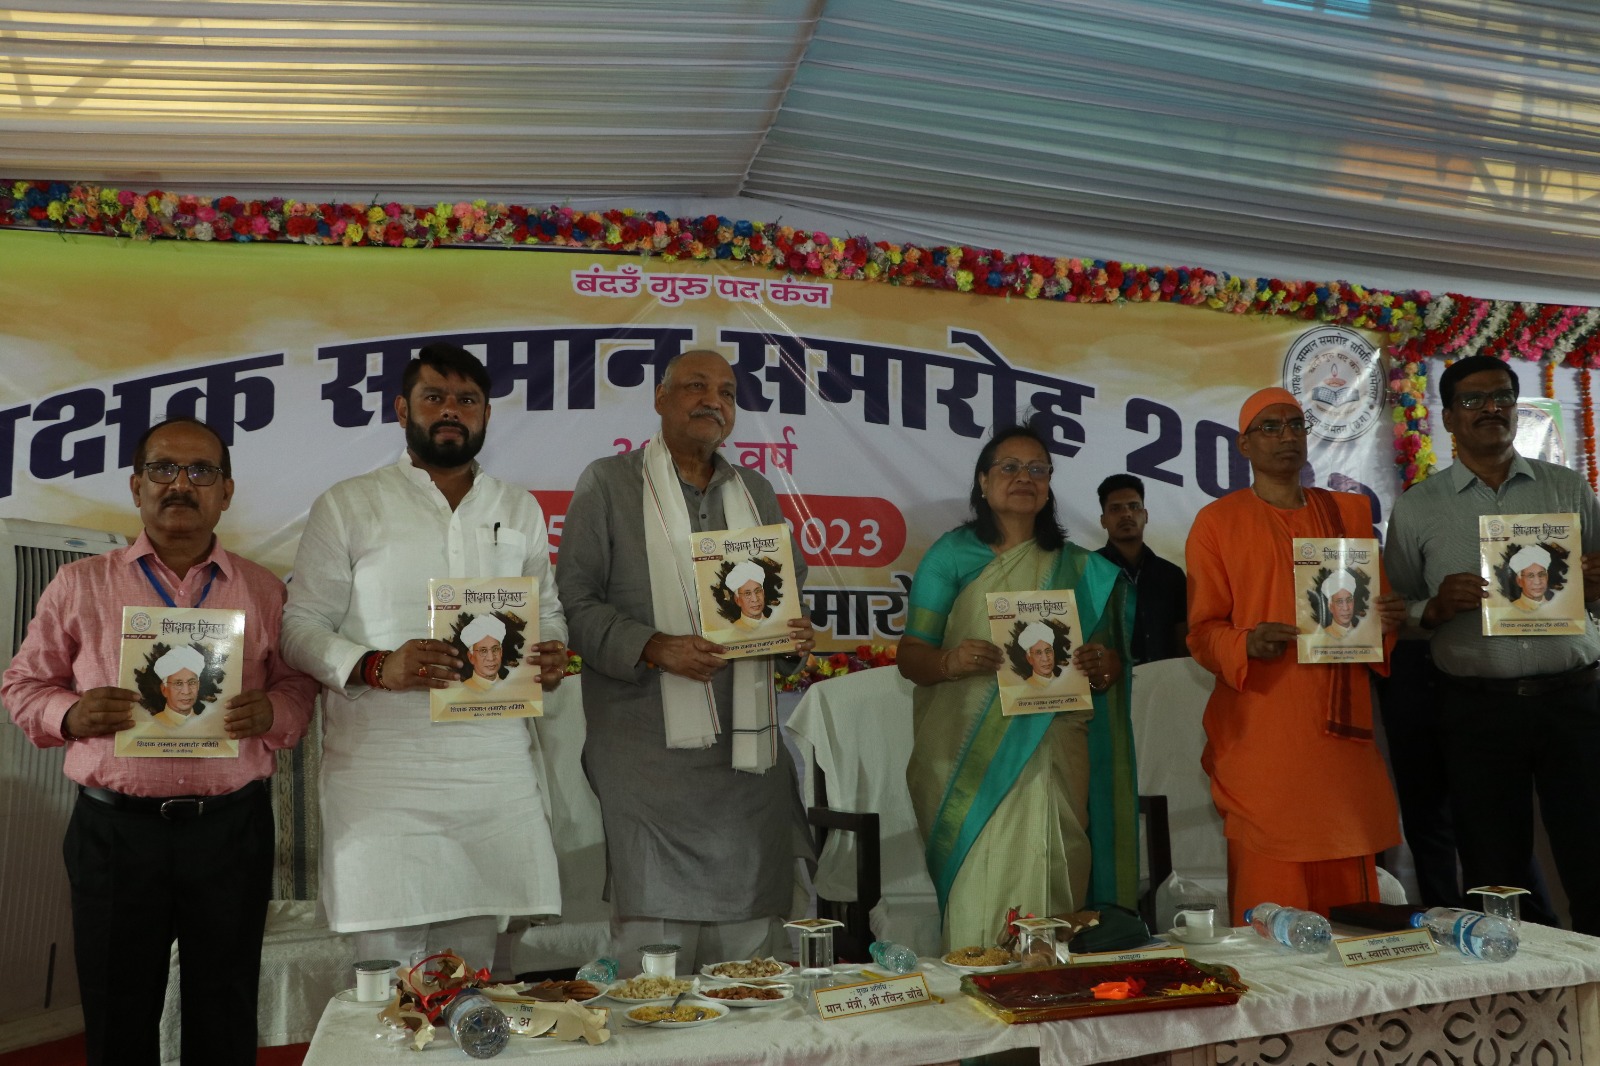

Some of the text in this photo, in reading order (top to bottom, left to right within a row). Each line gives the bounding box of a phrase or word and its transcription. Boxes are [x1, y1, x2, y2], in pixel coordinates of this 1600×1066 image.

[576, 266, 829, 304] बंदउँ गुरु पद कंज
[1296, 339, 1319, 362] सम्मान
[1318, 332, 1349, 347] समारोह
[721, 329, 1095, 459] समारोह
[734, 426, 798, 475] वर्ष
[784, 517, 883, 557] 023
[825, 1003, 845, 1014] मान.
[845, 996, 867, 1010] मंत्री,
[869, 993, 880, 1007] श्री
